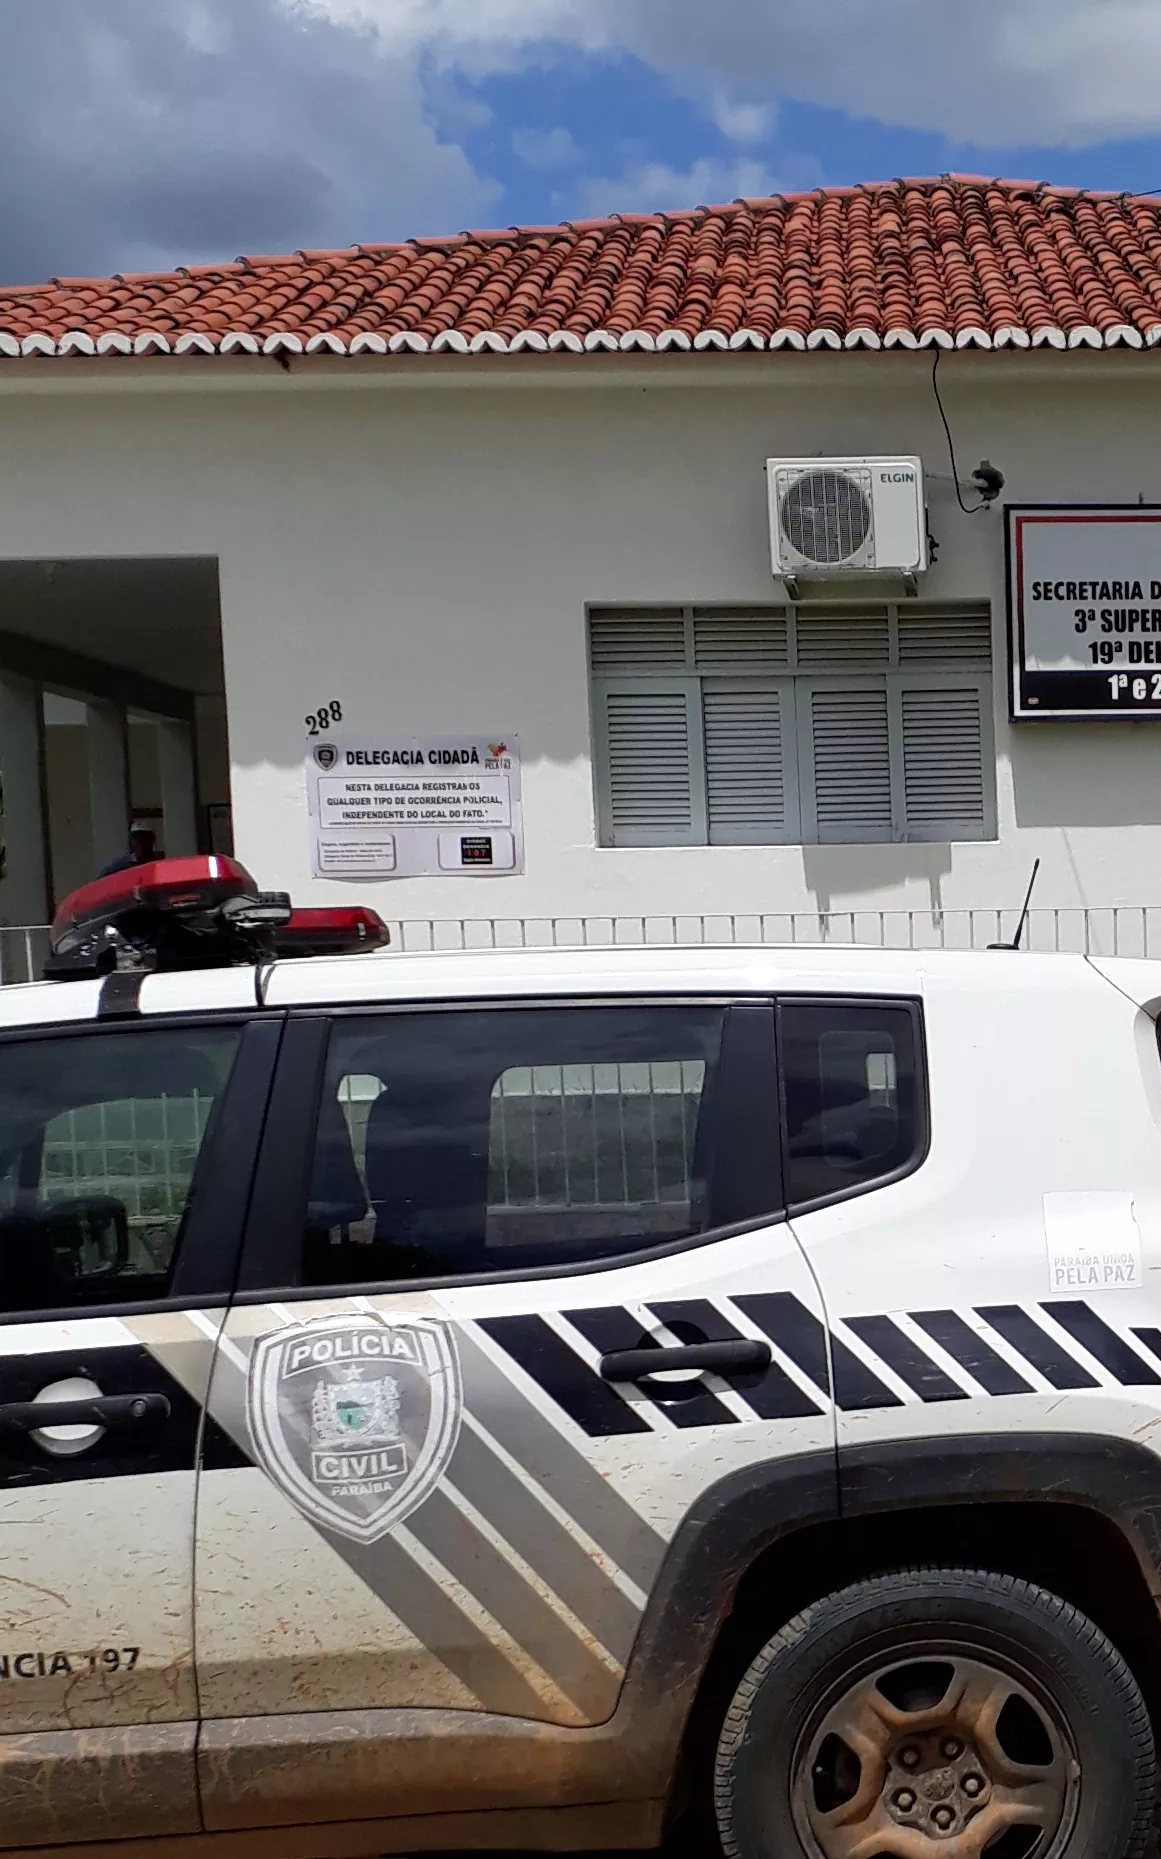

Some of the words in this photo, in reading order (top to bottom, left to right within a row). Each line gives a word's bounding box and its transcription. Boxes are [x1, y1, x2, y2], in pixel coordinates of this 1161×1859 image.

[880, 473, 914, 484] ELGIN
[1032, 581, 1143, 601] SECRETARIA
[1074, 609, 1096, 633] 3ª
[1088, 640, 1122, 664] 19ª
[1108, 673, 1128, 700] 1ª
[1132, 677, 1147, 699] e
[305, 700, 343, 735] 288
[346, 750, 424, 765] DELEGACIA
[428, 747, 480, 764] CIDADÃ
[345, 783, 372, 792] NESTA
[374, 783, 420, 792] DELEGACIA
[327, 797, 371, 806] QUALQUER
[373, 797, 392, 805] TIPO
[395, 797, 405, 805] DE
[342, 811, 404, 819] INDEPENDENTE
[407, 811, 418, 819] DO
[421, 810, 447, 818] LOCAL
[449, 810, 461, 818] DO
[1055, 1266, 1099, 1285] PELA
[1103, 1264, 1136, 1283] PAZ
[291, 1331, 415, 1369] POLÍCIA
[320, 1452, 398, 1479] CIVIL
[331, 1480, 393, 1497] PARAÍBA
[83, 1647, 140, 1674] 197
